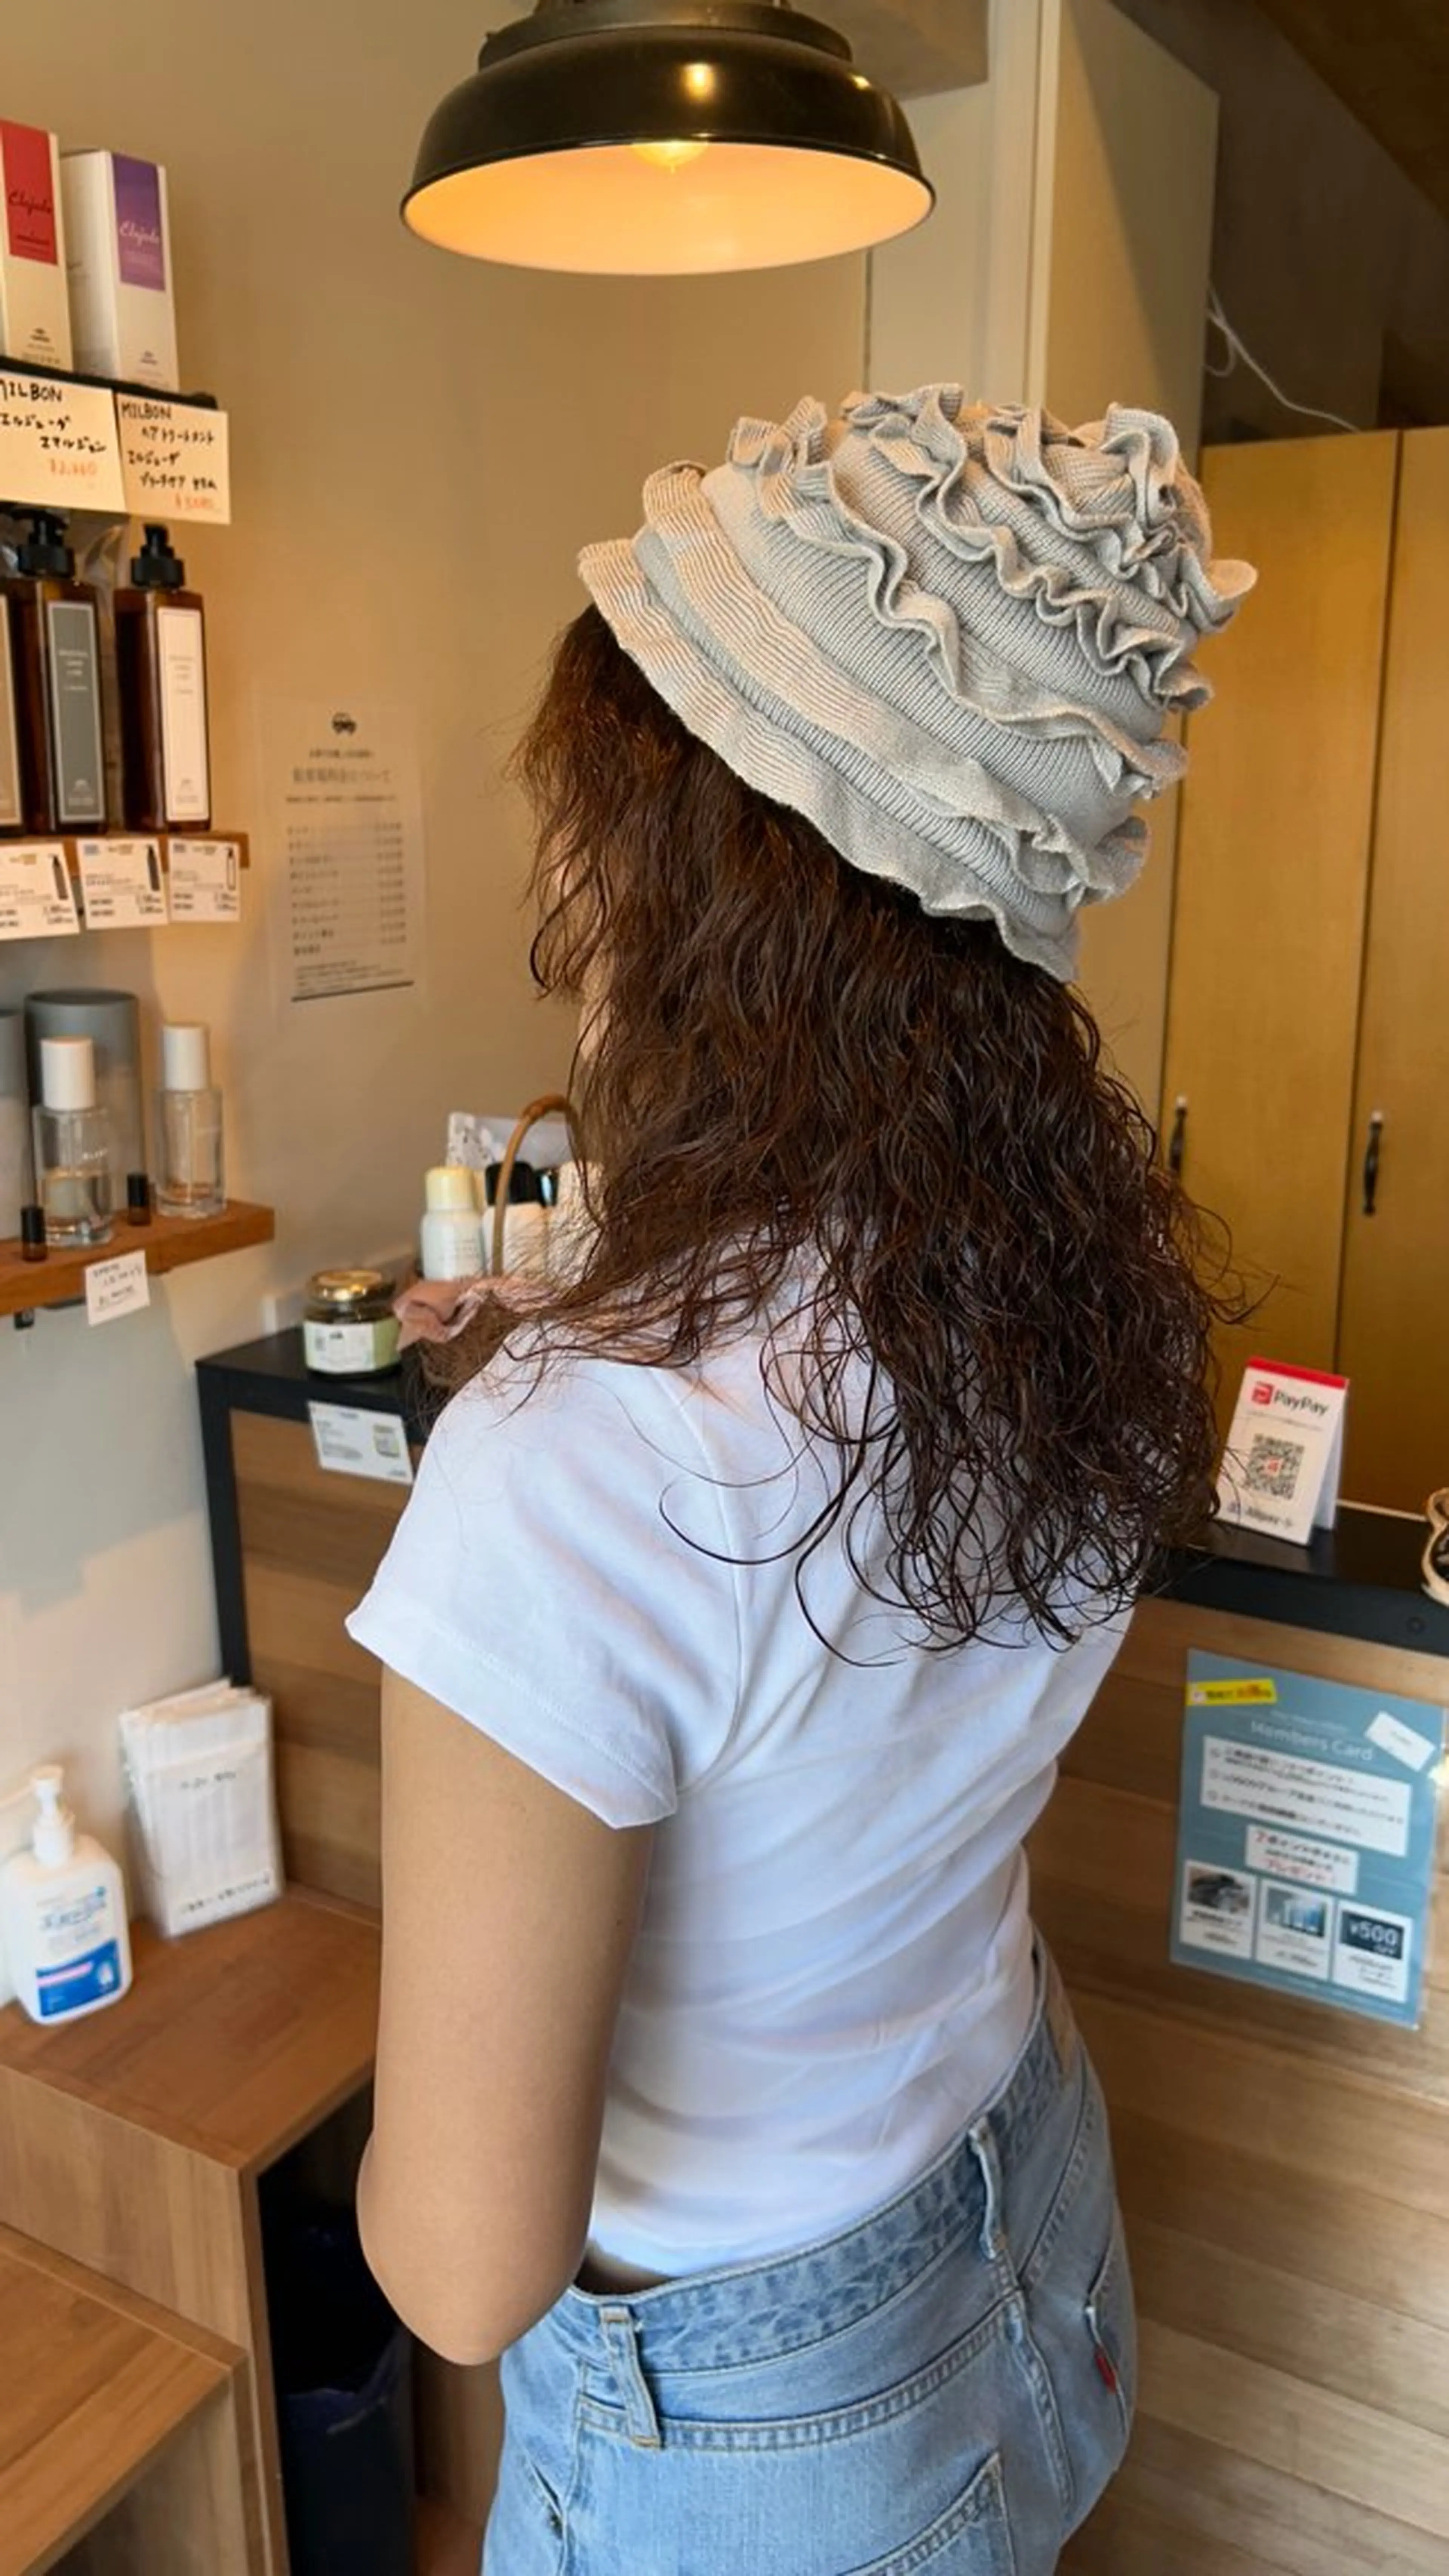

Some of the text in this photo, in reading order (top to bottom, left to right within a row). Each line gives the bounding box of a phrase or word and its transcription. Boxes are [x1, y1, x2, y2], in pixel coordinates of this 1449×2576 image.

[121, 401, 172, 420] MILBON
[1274, 1390, 1328, 1415] PayPay
[1332, 1739, 1374, 1762] Card
[1349, 1921, 1400, 1946] ¥500
